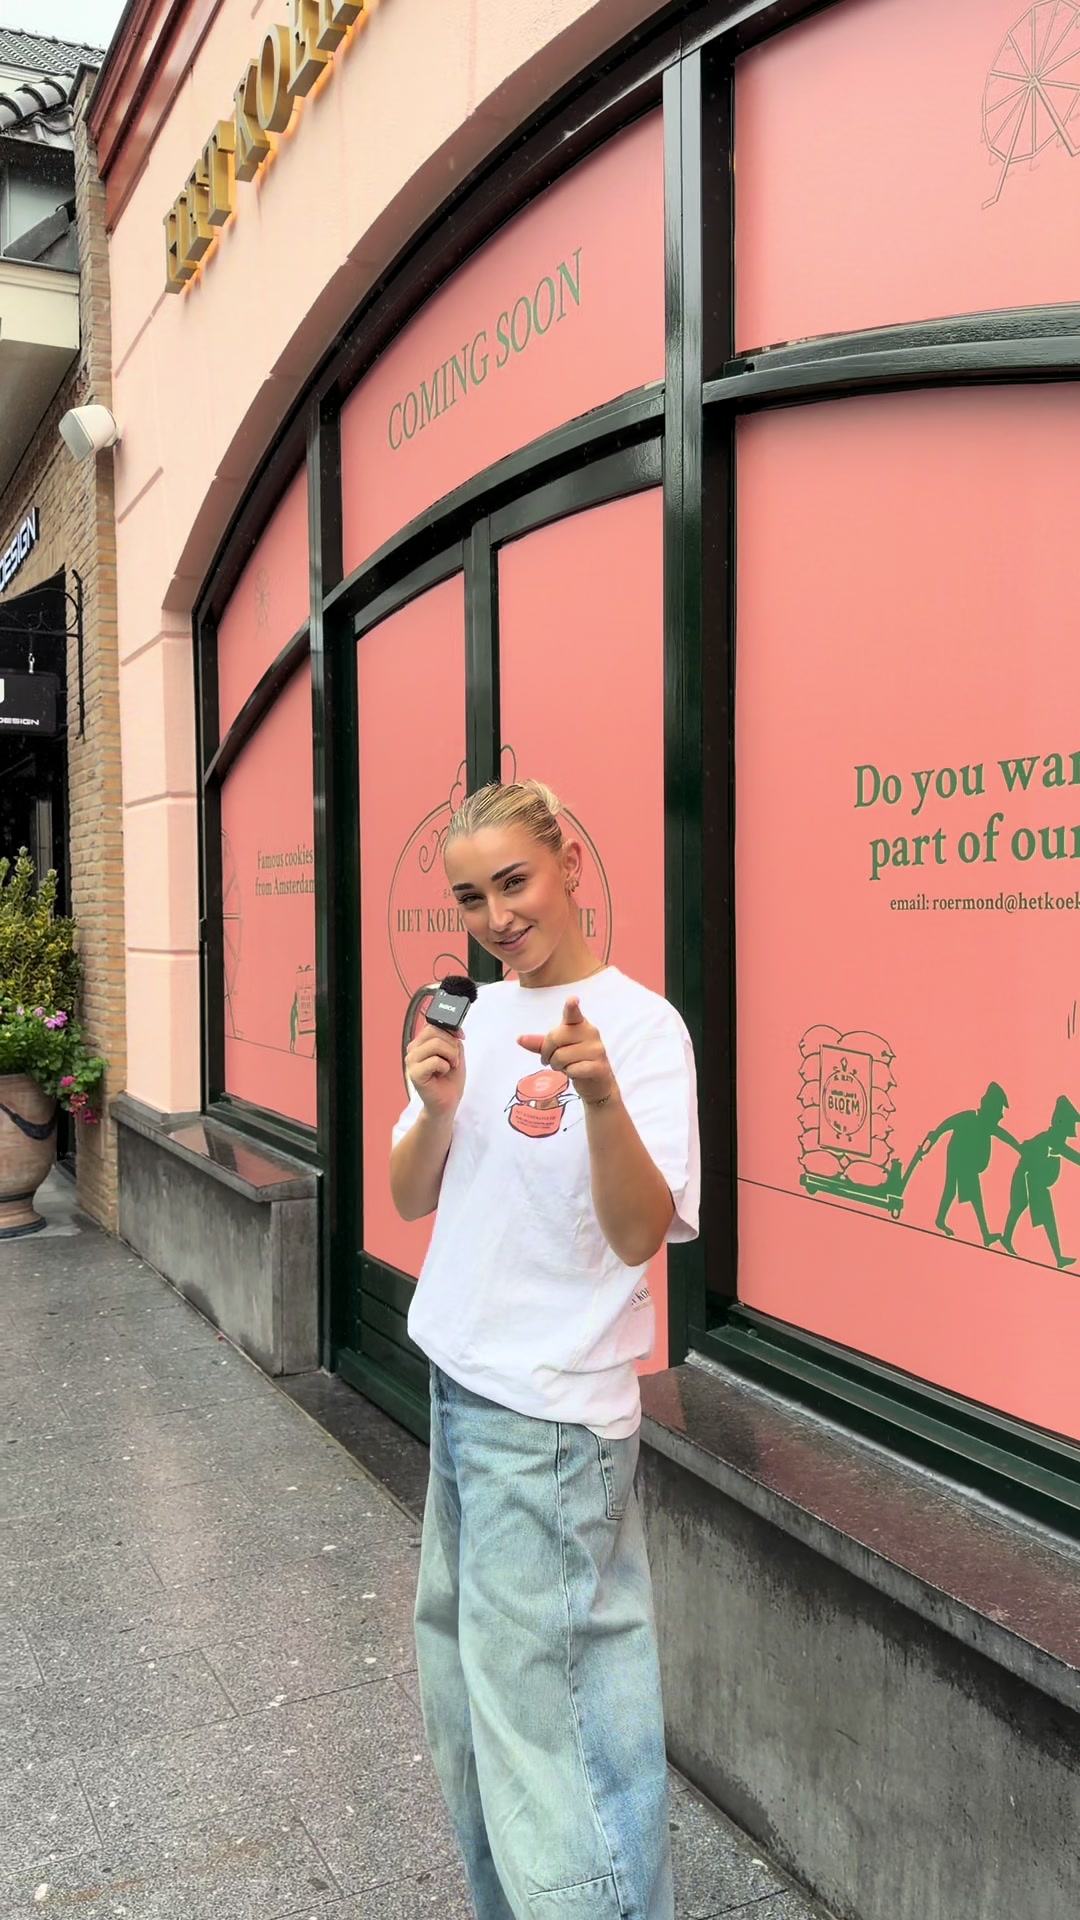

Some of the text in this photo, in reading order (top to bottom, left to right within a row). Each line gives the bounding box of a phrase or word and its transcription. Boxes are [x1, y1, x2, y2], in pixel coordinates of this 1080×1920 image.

[163, 120, 235, 294] HET
[388, 247, 582, 450] COMING SOON
[854, 764, 902, 808] Do
[911, 763, 985, 816] you
[257, 843, 314, 870] Famous cookies
[869, 828, 947, 881] part
[957, 812, 1004, 863] of
[255, 876, 273, 897] from
[890, 893, 929, 911] email:
[397, 909, 422, 932] HET
